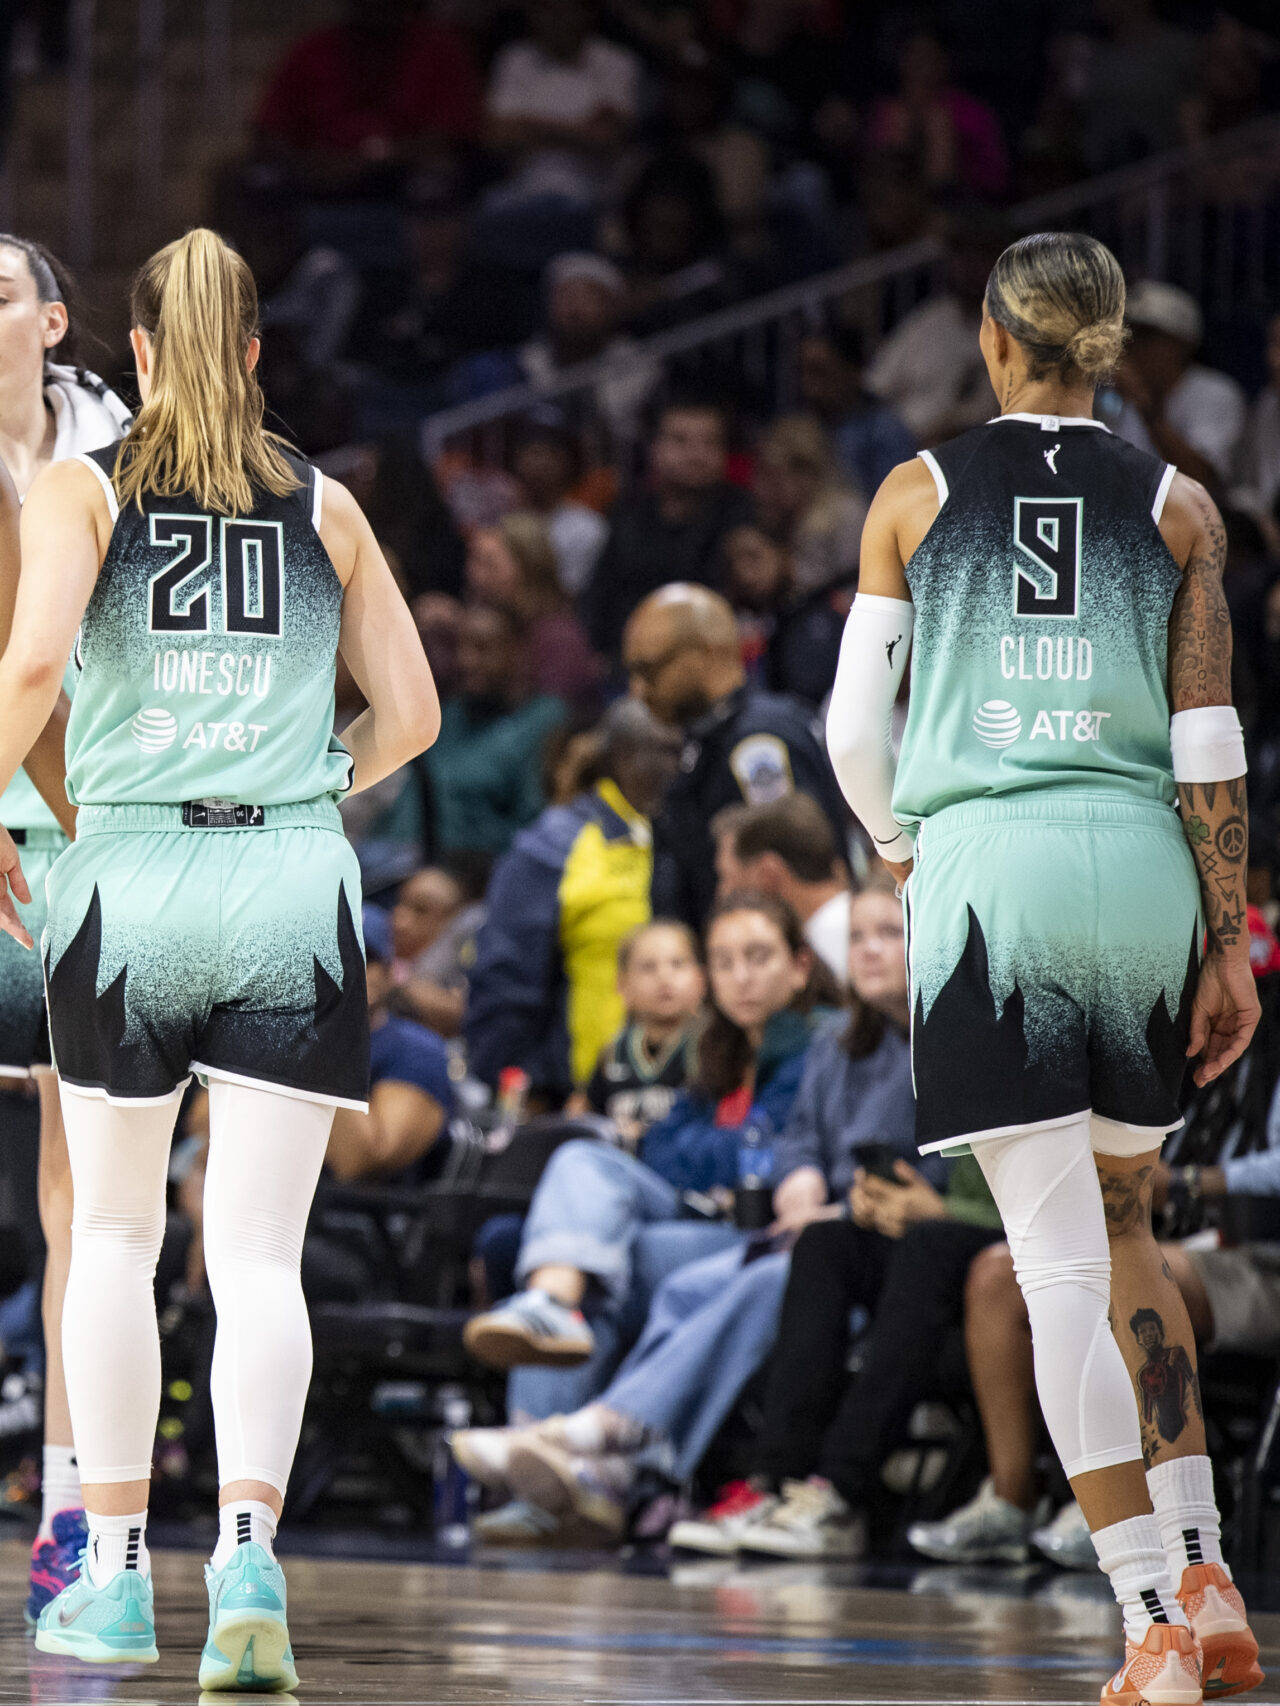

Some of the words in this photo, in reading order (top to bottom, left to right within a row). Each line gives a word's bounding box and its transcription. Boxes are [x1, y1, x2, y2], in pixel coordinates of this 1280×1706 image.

[148, 513, 284, 640] 20
[1014, 496, 1083, 620] 9
[153, 649, 272, 698] IONESCU
[1000, 635, 1093, 681] CLOUD
[182, 721, 269, 753] AT&T
[1028, 710, 1112, 742] AT&T
